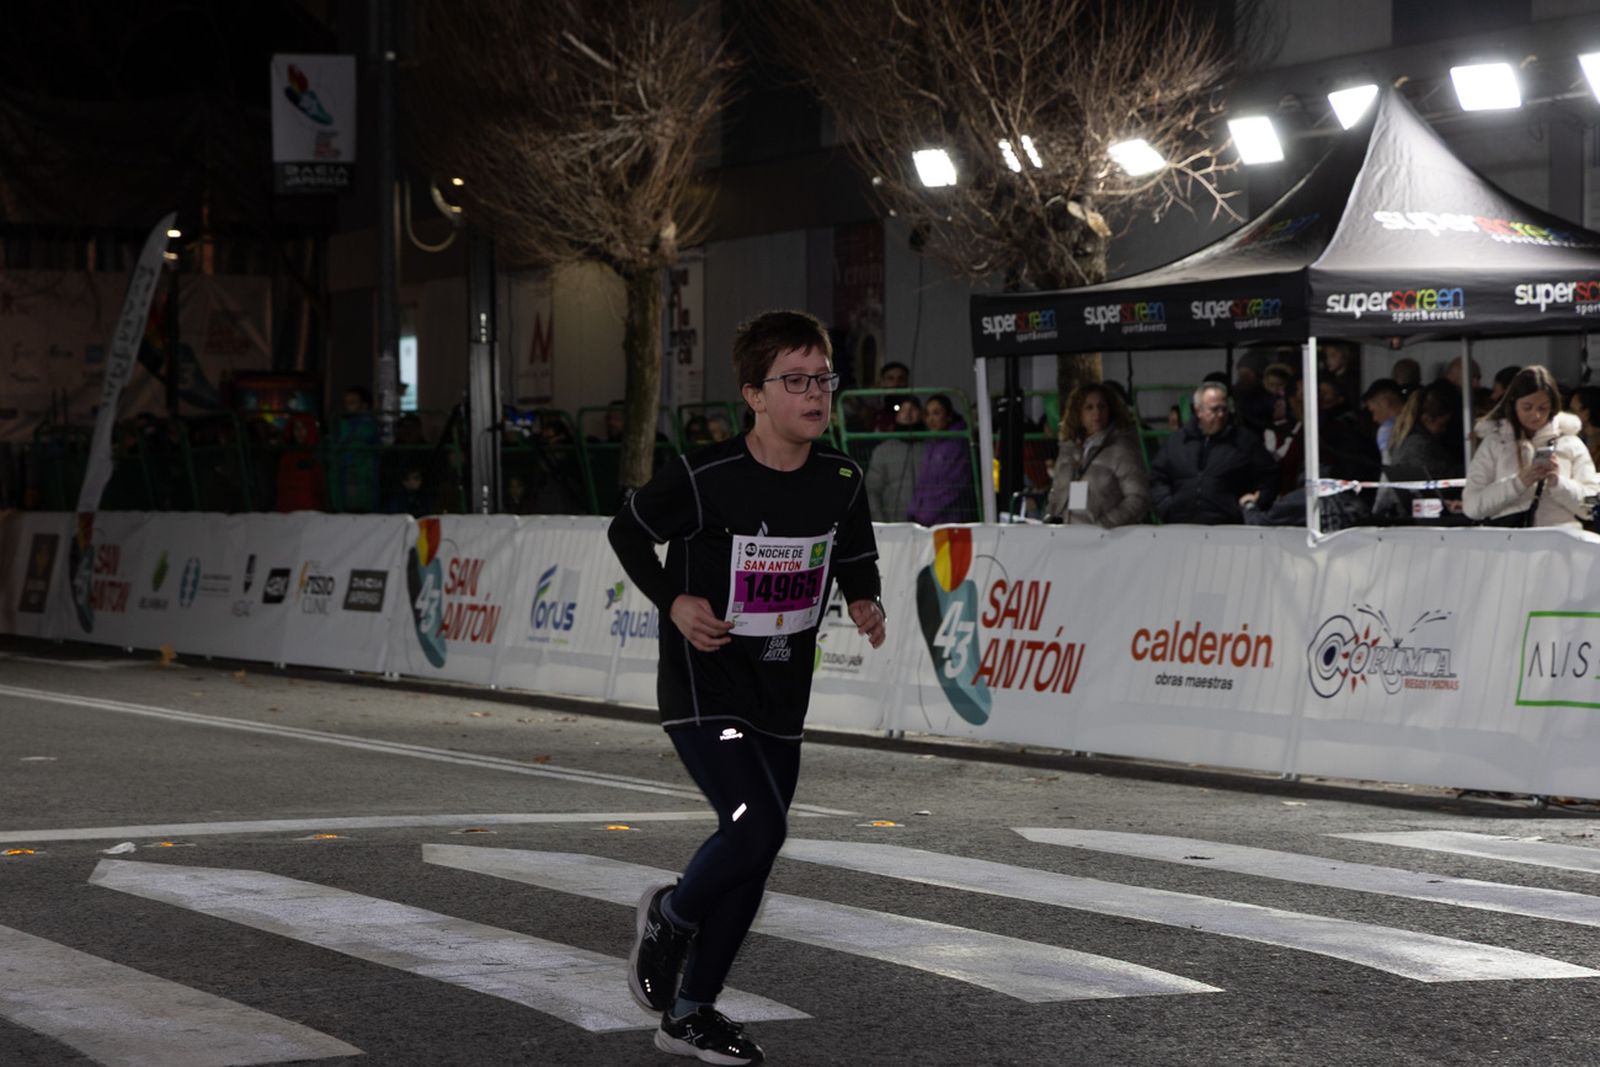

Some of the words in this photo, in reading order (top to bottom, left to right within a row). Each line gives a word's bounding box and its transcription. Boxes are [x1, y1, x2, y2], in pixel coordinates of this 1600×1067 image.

[1326, 287, 1464, 319] superscreen
[1514, 280, 1600, 312] supersc
[982, 309, 1057, 340] superscreen
[1083, 301, 1165, 331] superscreen
[1190, 298, 1281, 328] superscreen
[1391, 309, 1466, 324] sport&events
[744, 559, 765, 571] SAN
[768, 557, 803, 572] ANTÓN
[758, 549, 791, 559] NOCHE
[792, 548, 804, 559] DE
[444, 557, 486, 597] SAN
[743, 572, 818, 603] 14965
[415, 573, 440, 634] 43
[435, 592, 502, 644] ANTÓN
[982, 578, 1052, 631] SAN
[610, 602, 659, 648] aquali
[933, 601, 976, 679] 43
[970, 625, 1086, 694] ANTÓN
[1131, 620, 1273, 668] calderón
[1527, 640, 1600, 679] ALIS
[1155, 672, 1183, 687] obras
[1185, 676, 1234, 690] maestras
